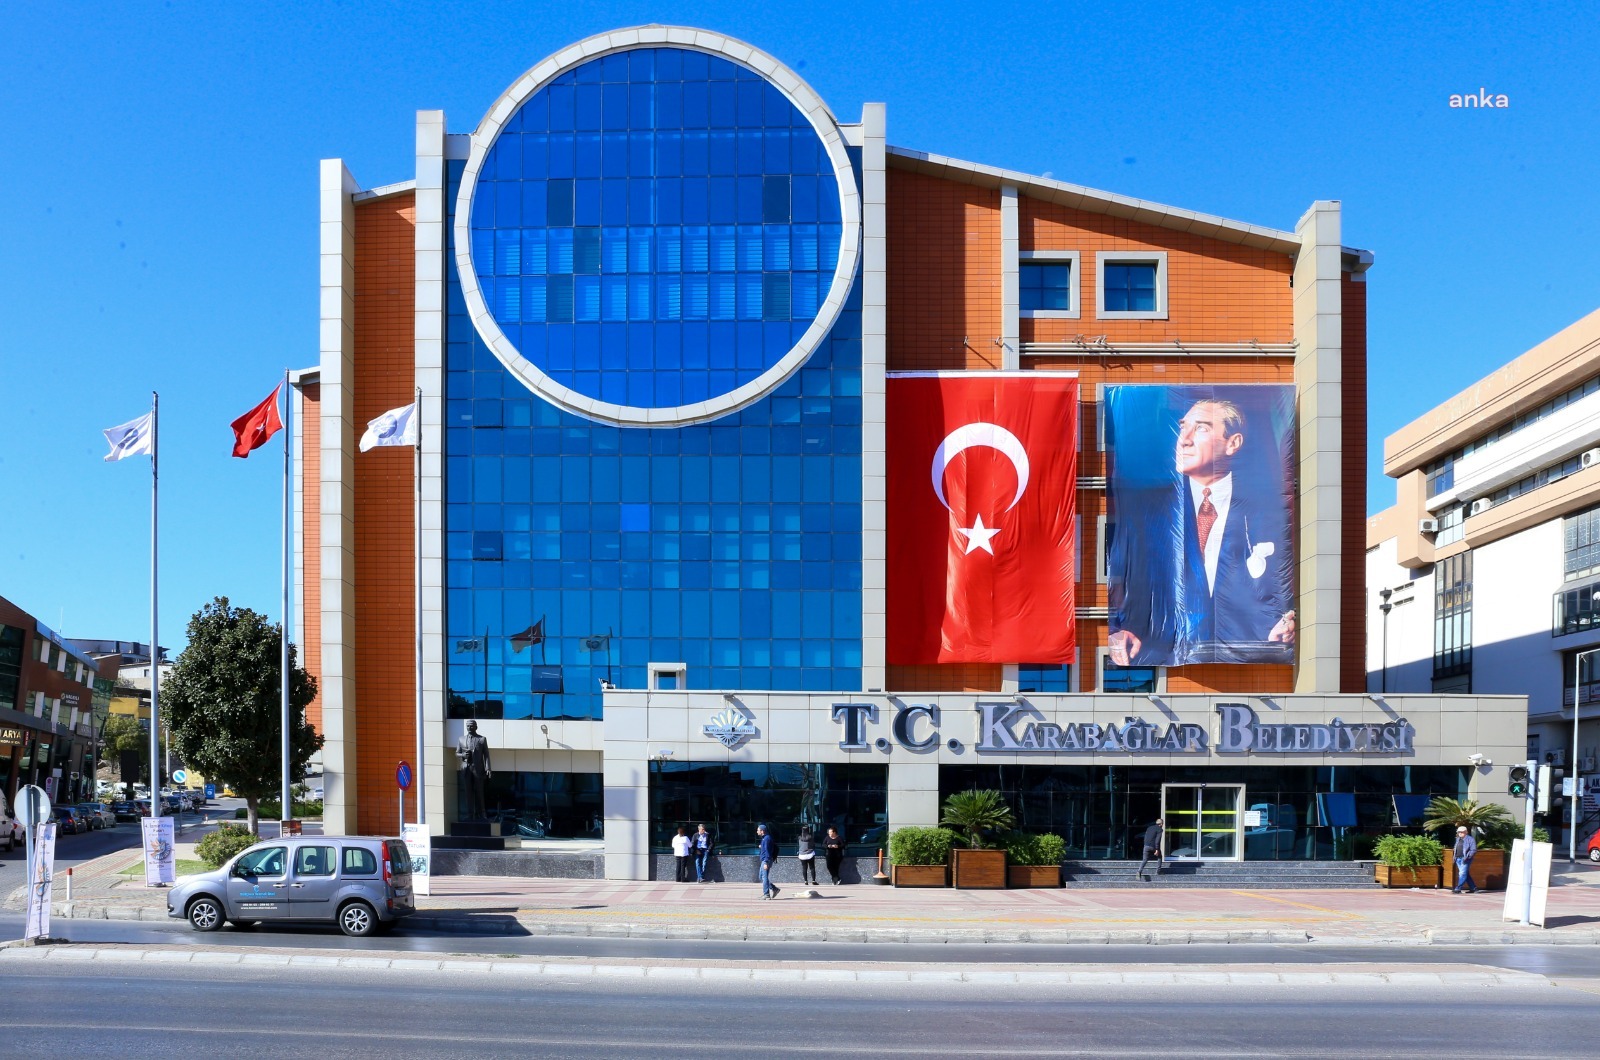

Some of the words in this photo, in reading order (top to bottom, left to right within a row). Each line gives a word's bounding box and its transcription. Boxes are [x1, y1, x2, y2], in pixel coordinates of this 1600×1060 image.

[832, 703, 960, 750] T.C.
[976, 703, 1204, 751] KARABAĞLAR
[1217, 704, 1408, 751] BELEDİYESİ
